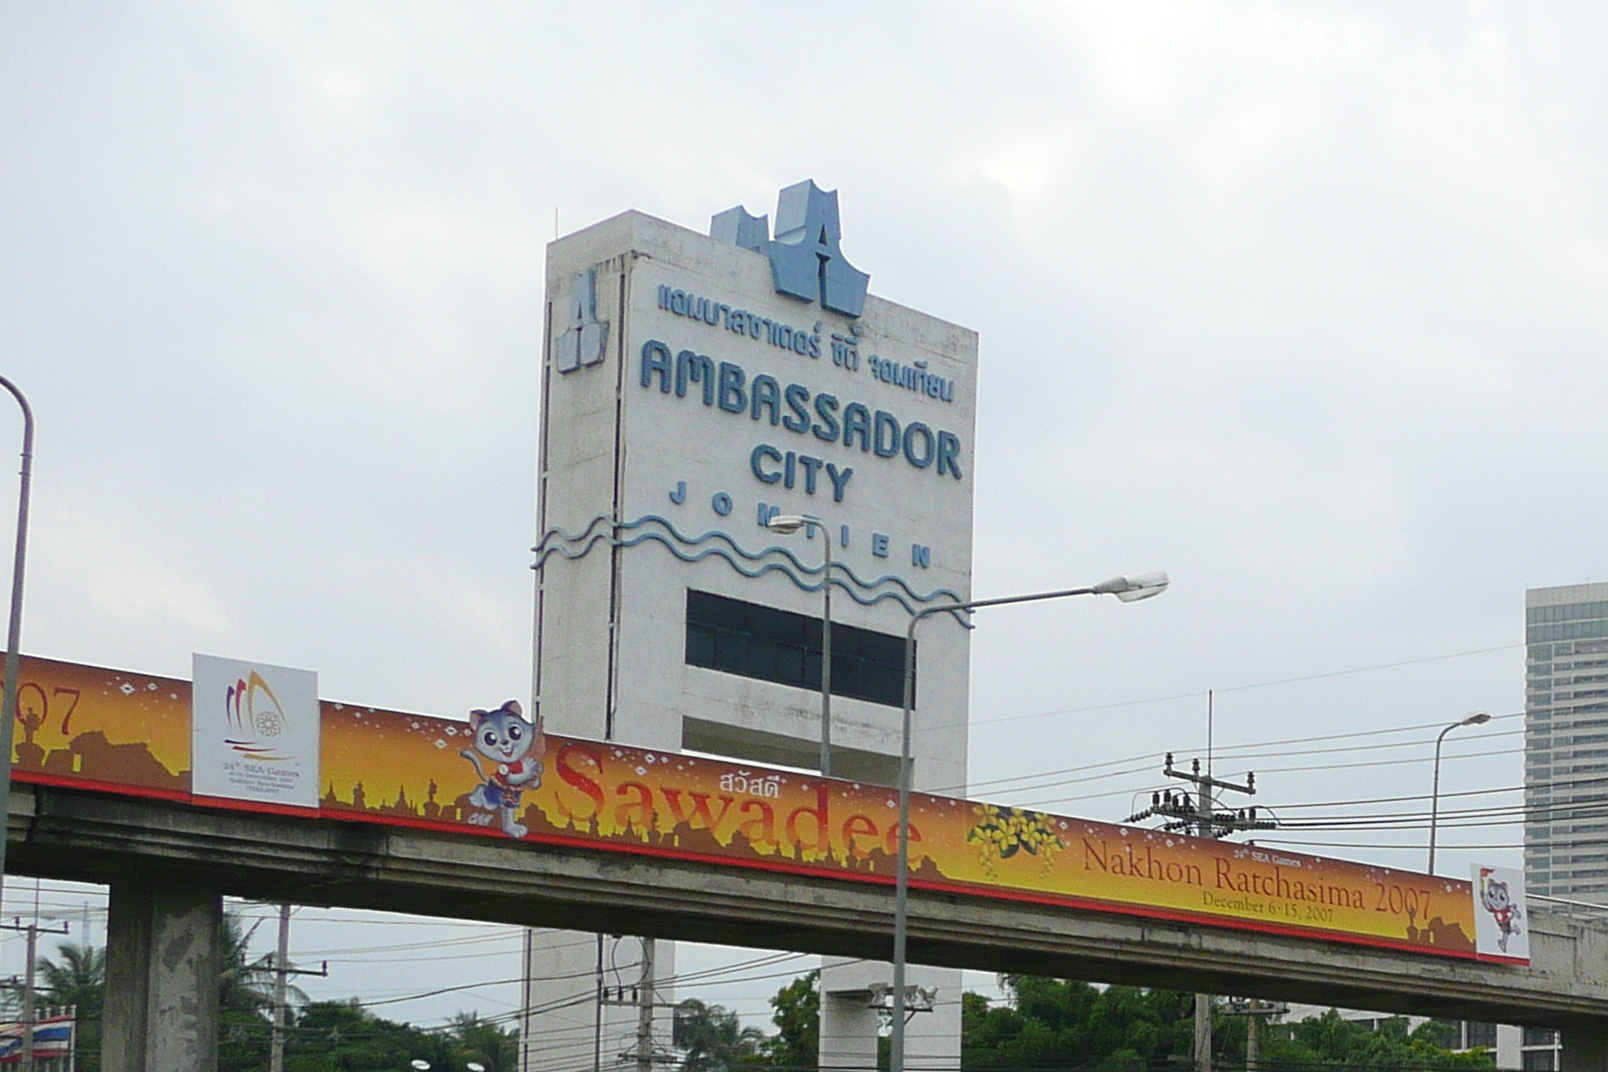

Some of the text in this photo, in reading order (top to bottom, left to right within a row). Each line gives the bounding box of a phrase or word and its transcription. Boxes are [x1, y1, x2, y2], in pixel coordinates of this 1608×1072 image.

[640, 338, 963, 480] AMBASSADOR
[750, 444, 854, 501] CITY
[0, 682, 81, 736] 07
[554, 744, 923, 862] Sawadee
[719, 770, 780, 799] สวัสดี
[1082, 838, 1431, 920] Nakhon Ratchasima 2007
[1203, 890, 1265, 914] December
[1306, 905, 1334, 923] 2007
